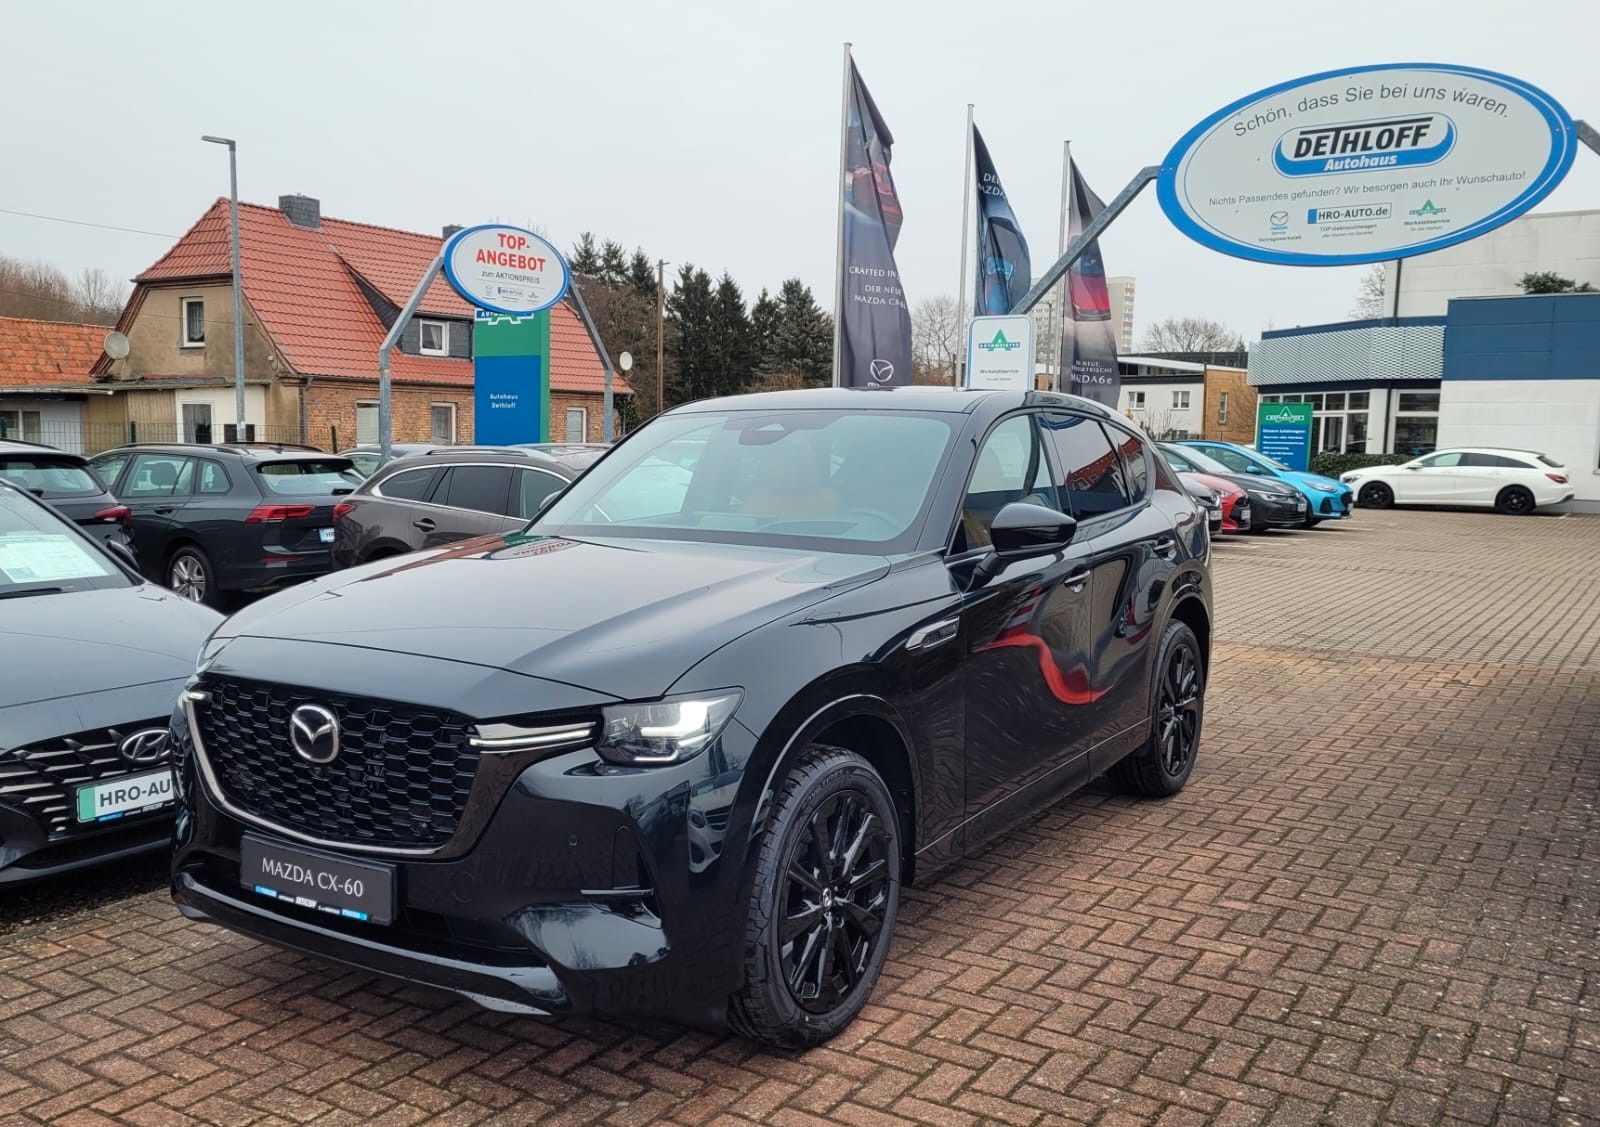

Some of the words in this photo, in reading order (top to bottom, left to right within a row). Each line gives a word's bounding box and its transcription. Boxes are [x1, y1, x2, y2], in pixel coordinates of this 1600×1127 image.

[1233, 108, 1292, 137] Schön,
[1297, 93, 1339, 112] dass
[1345, 86, 1374, 102] Sie
[1380, 83, 1408, 99] bei
[1413, 86, 1447, 100] uns
[1453, 89, 1508, 118] waren.
[1294, 117, 1433, 158] DETHLOFF
[1324, 155, 1398, 171] Autohaus
[1209, 196, 1237, 206] Nichts
[1238, 191, 1289, 204] Passendes
[1291, 187, 1341, 199] gefunden?
[1343, 185, 1360, 195] Wir
[1362, 182, 1409, 193] besorgen
[1411, 178, 1437, 189] auch
[1439, 177, 1453, 187] Ihr
[1456, 171, 1526, 185] Wunschauto!
[1318, 206, 1388, 220] HRO-AUTO.de
[498, 233, 530, 250] TOP-
[476, 248, 546, 273] ANGEBOT
[481, 270, 495, 278] zum
[496, 271, 540, 284] AKTIONSPREIS
[849, 266, 885, 277] CRAFTED
[865, 284, 881, 293] DER
[855, 294, 886, 305] MAZDA
[261, 857, 314, 887] MAZDA
[317, 871, 364, 898] CX-60
